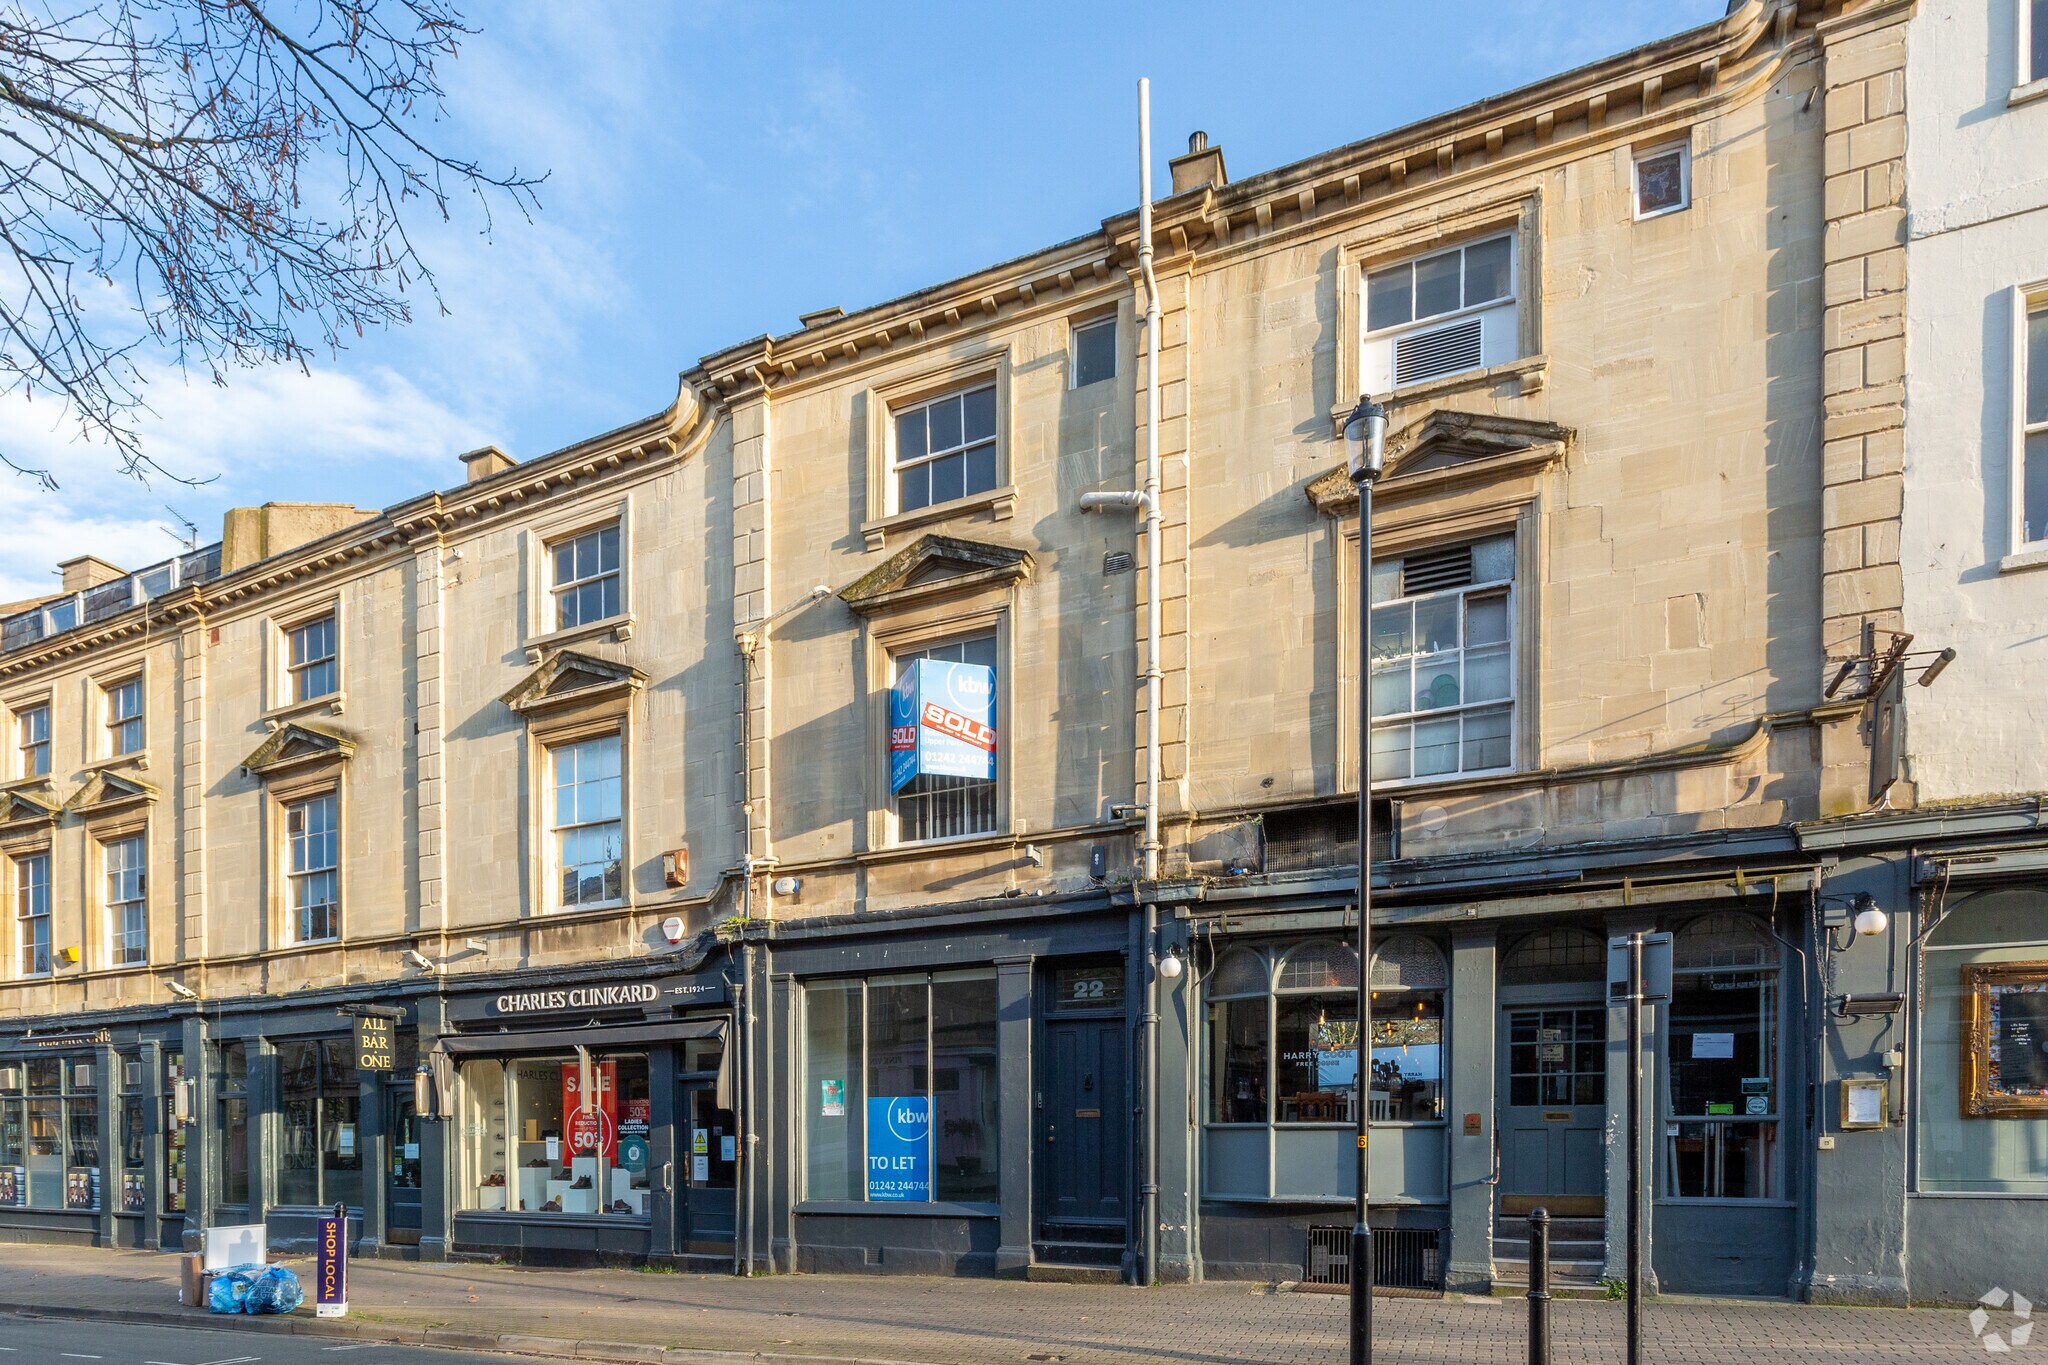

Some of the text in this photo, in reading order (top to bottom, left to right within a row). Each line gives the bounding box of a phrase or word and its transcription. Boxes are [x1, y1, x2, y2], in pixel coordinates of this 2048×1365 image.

[902, 680, 915, 702] kbw
[957, 674, 993, 695] kbw
[926, 704, 996, 745] SOLD
[891, 728, 916, 744] SOLD
[924, 752, 994, 767] 01242 244744
[674, 986, 705, 994] EST.1924
[1074, 981, 1103, 998] 22
[496, 984, 658, 1012] CHARLES CLINKARD
[361, 1018, 387, 1031] ALL
[361, 1036, 389, 1049] BAR
[361, 1055, 391, 1068] ONE
[1283, 1050, 1353, 1060] HARRY COOK
[897, 1108, 929, 1124] kbw
[1358, 1137, 1366, 1147] 6
[869, 1156, 917, 1170] TO LET
[869, 1181, 929, 1191] 01242 244744
[325, 1222, 337, 1257] SHOP
[325, 1260, 336, 1300] LOCAL
